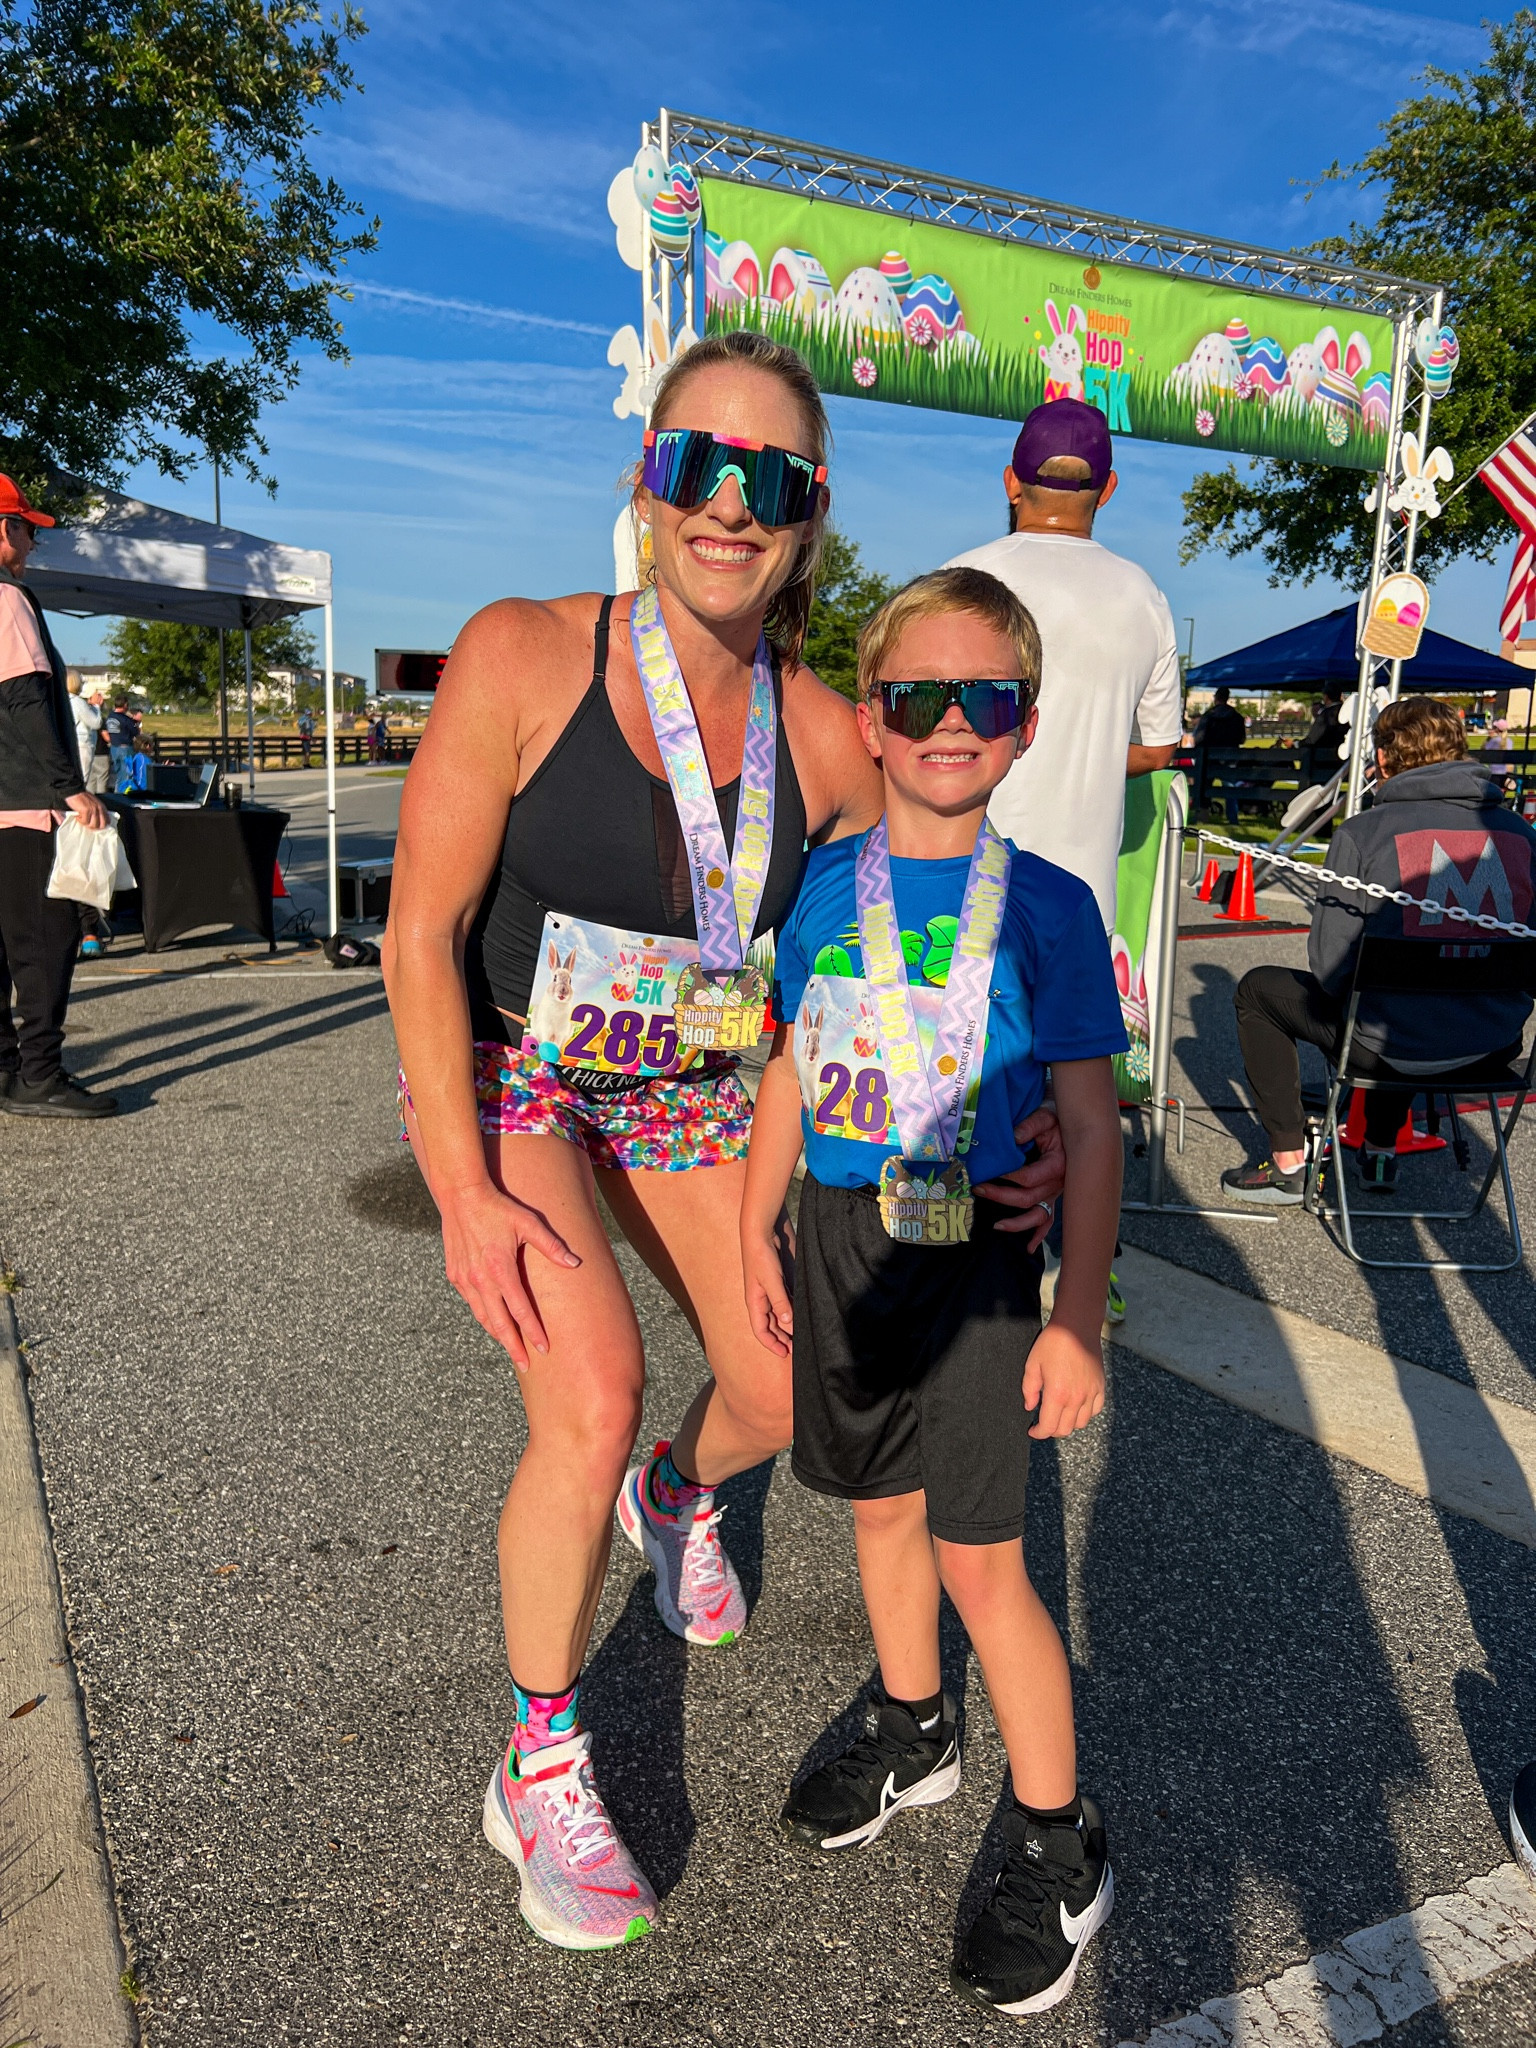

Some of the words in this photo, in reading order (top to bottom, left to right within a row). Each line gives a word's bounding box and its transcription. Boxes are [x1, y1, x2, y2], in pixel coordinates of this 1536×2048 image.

[1087, 309, 1132, 338] Hippity
[1086, 331, 1124, 371] Hop
[1085, 366, 1133, 433] 5K
[638, 625, 671, 679] Hop
[652, 679, 687, 718] 5K
[742, 784, 769, 819] 5K
[689, 832, 701, 865] DREAM
[736, 822, 769, 872] Hop
[695, 865, 707, 901] FINDERS
[1419, 835, 1516, 927] M
[700, 900, 711, 933] HOMES
[959, 877, 1006, 959] Hippity
[862, 901, 900, 985] Hippity
[640, 964, 663, 980] Hop
[634, 979, 666, 1005] 5K
[684, 1009, 722, 1026] Hippity
[720, 1011, 761, 1048] 5K
[876, 989, 909, 1040] Hop
[563, 1003, 679, 1070] 285
[682, 1024, 716, 1048] Hop
[963, 1019, 977, 1051] HOMES
[888, 1041, 921, 1078] 5K
[955, 1050, 970, 1086] FINDERS
[815, 1062, 897, 1133] 28
[948, 1086, 963, 1117] DREAM
[888, 1201, 928, 1218] Hippity
[927, 1203, 970, 1242] 5K
[889, 1217, 923, 1242] Hop
